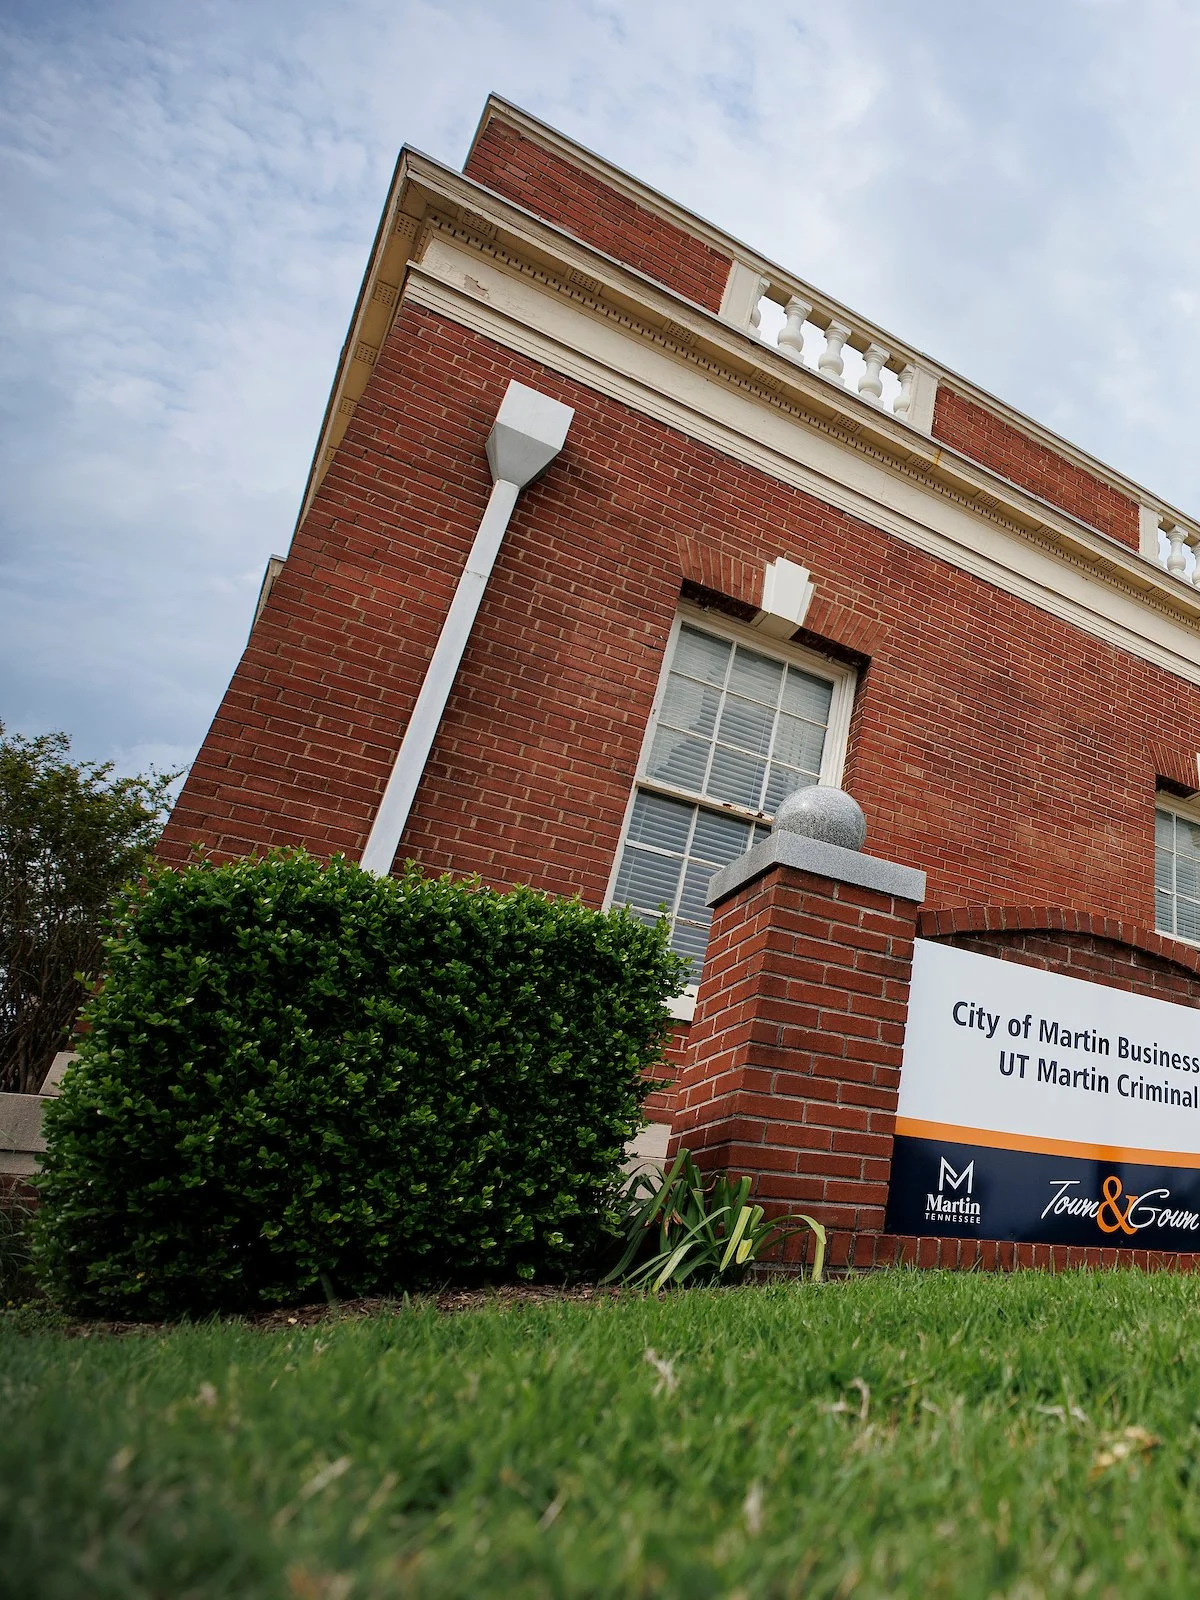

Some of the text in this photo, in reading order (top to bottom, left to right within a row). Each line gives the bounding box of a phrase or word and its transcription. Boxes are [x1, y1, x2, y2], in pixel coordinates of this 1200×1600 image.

[953, 1001, 1001, 1039] City
[1007, 1014, 1033, 1040] of
[1038, 1018, 1110, 1056] Martin
[1117, 1035, 1200, 1074] Business
[999, 1050, 1030, 1079] UT
[1037, 1057, 1109, 1094] Martin
[1117, 1073, 1198, 1109] Criminal
[924, 1212, 981, 1224] TENNESSEE
[925, 1193, 981, 1216] Martin
